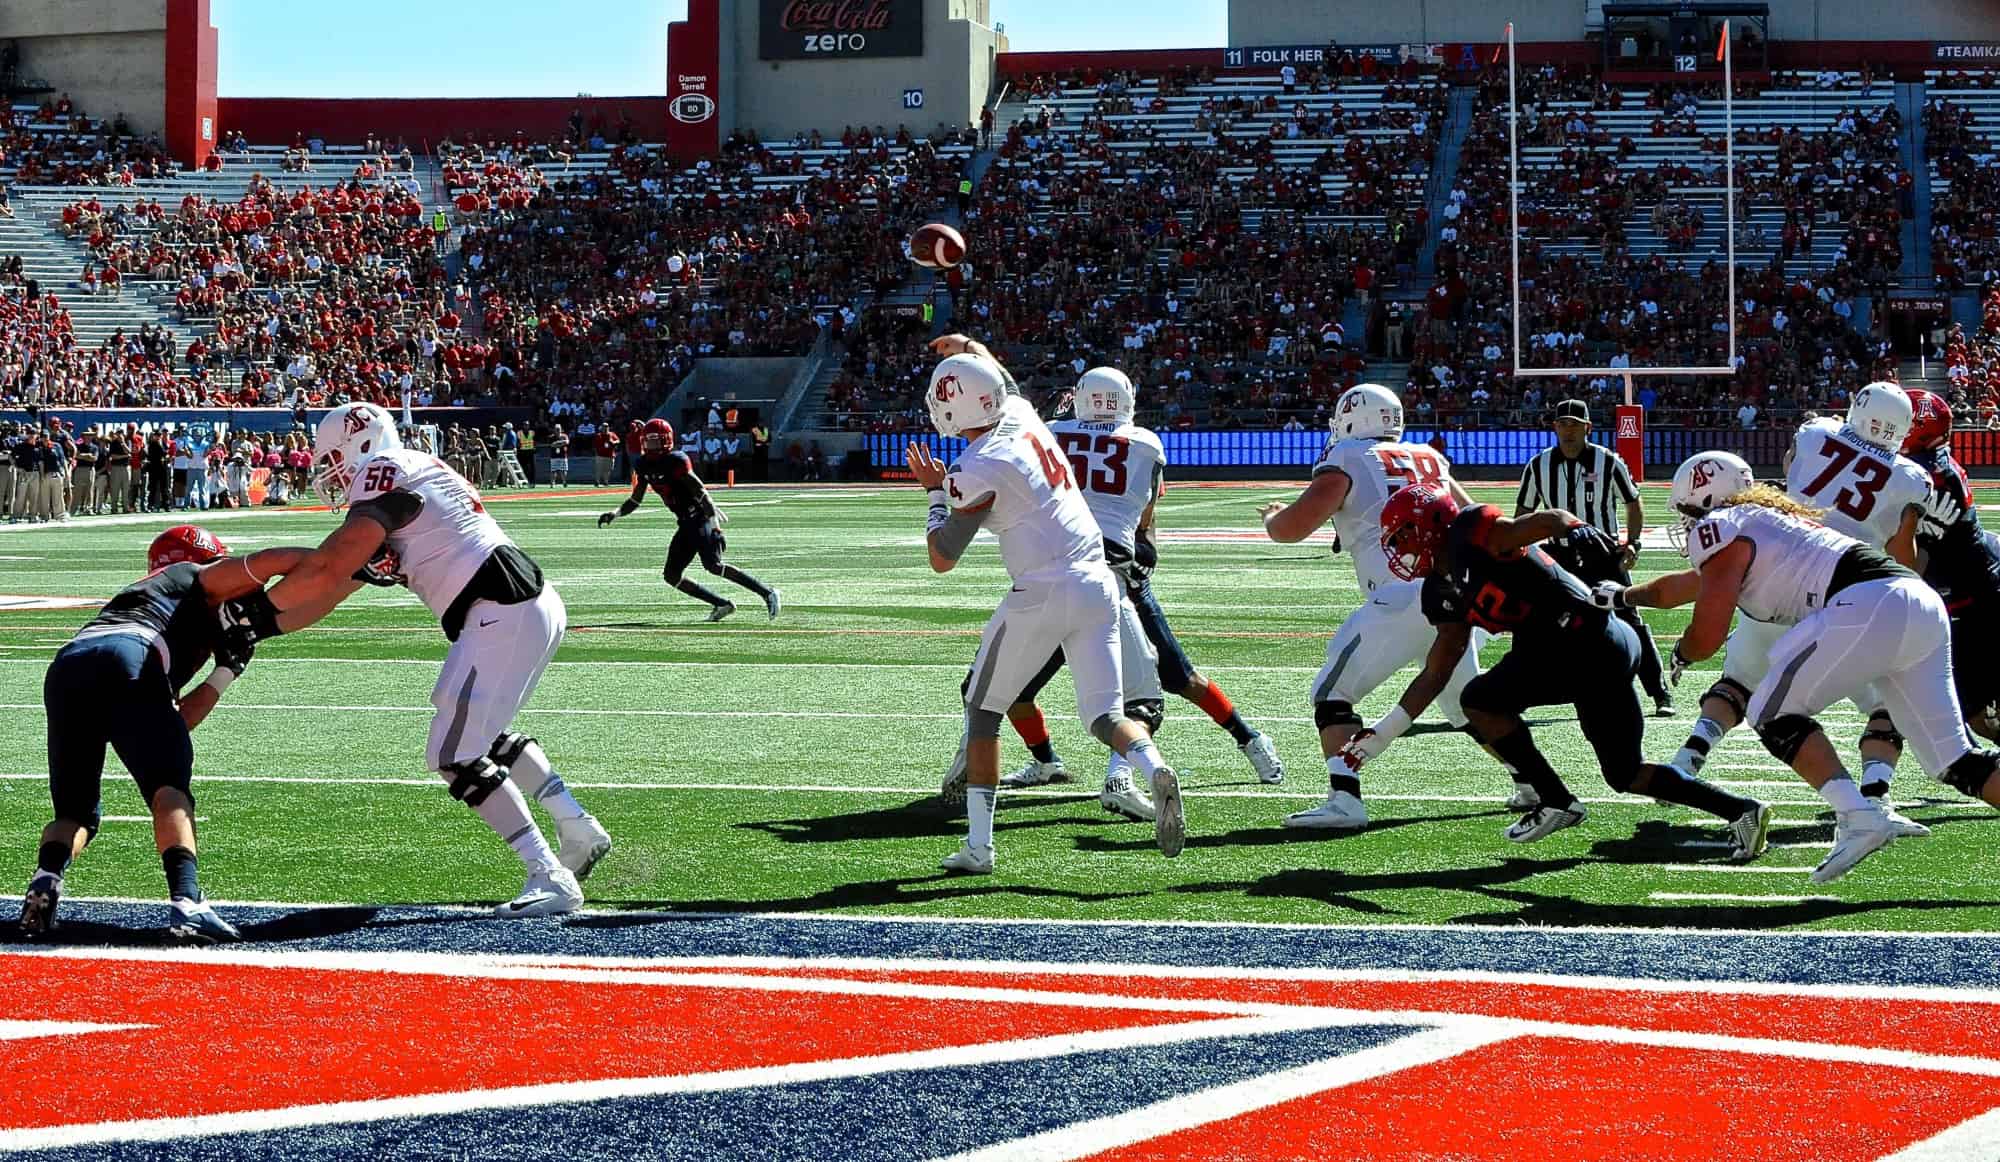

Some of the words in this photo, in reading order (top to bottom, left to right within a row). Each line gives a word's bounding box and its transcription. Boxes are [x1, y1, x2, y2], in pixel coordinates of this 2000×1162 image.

[804, 33, 865, 52] zero
[1227, 51, 1242, 65] 11
[1253, 50, 1289, 63] FOLK
[1680, 56, 1695, 71] 12
[904, 92, 923, 106] 10
[1023, 431, 1072, 490] 4
[1057, 432, 1130, 496] 63
[364, 466, 397, 492] 56
[1377, 450, 1444, 496] 58
[1800, 435, 1893, 522] 73
[949, 477, 963, 501] 4
[1586, 491, 1594, 502] U
[1697, 522, 1722, 550] 61
[1105, 777, 1129, 793] NIKE
